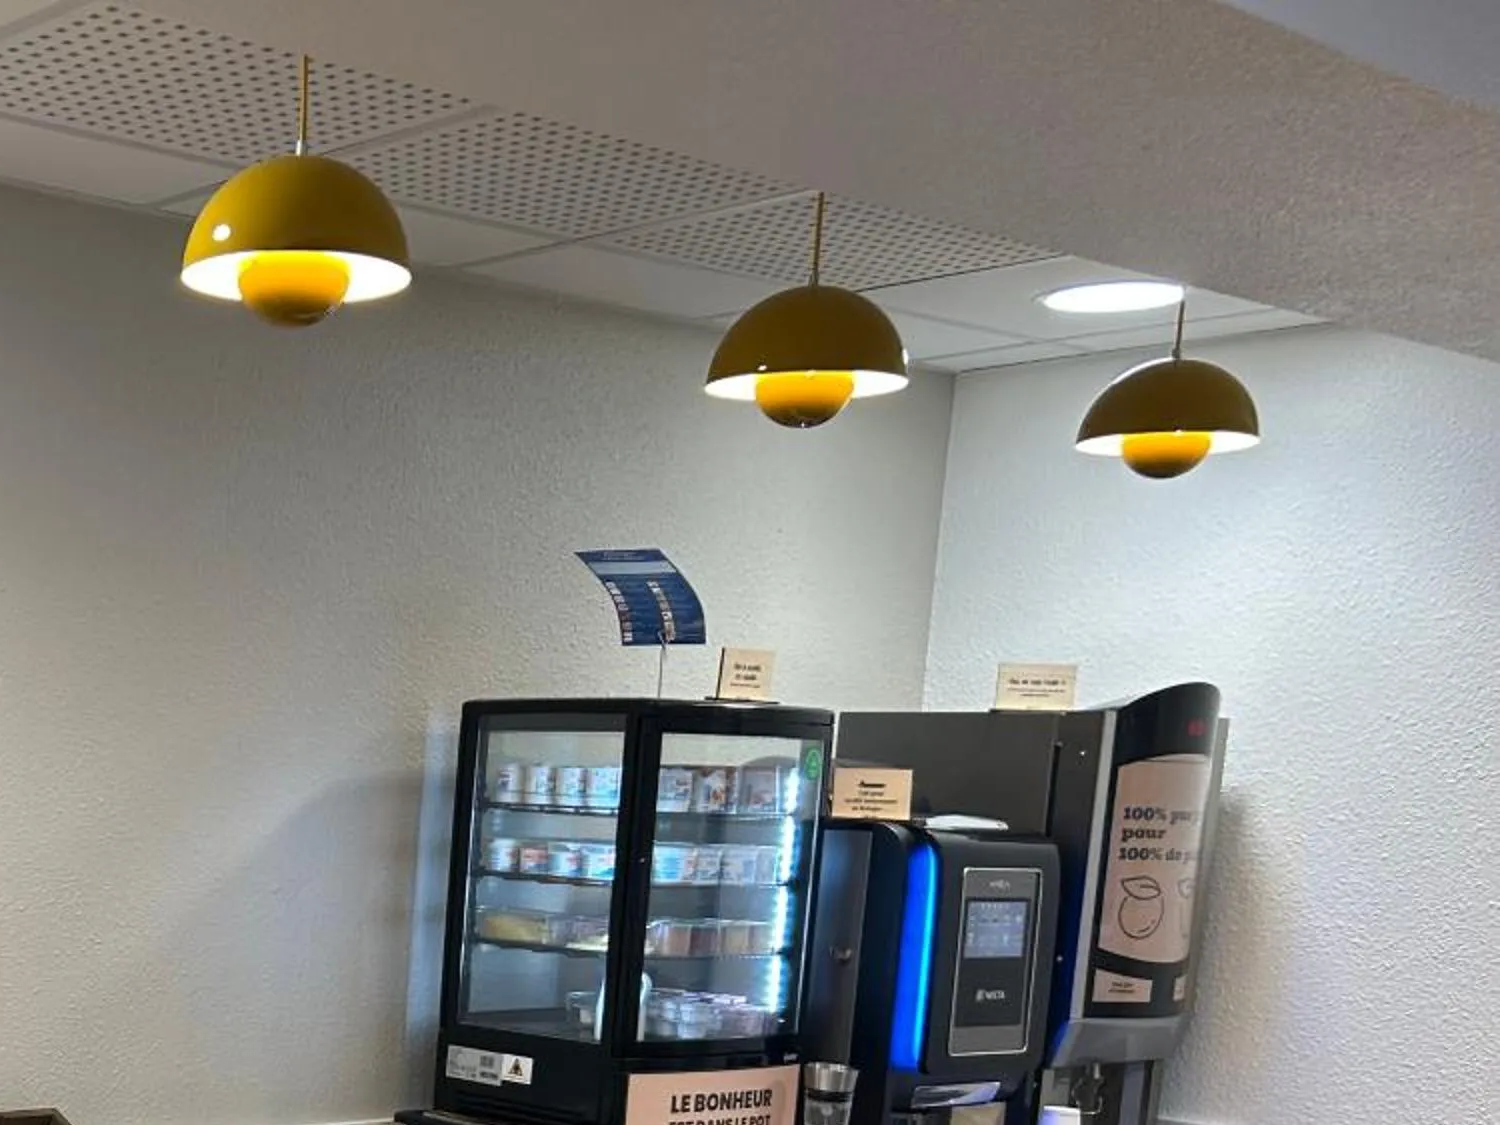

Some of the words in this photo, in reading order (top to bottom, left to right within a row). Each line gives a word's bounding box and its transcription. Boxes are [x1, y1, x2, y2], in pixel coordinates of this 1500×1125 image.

[1121, 827, 1167, 843] pour
[670, 1093, 690, 1114] LE
[694, 1089, 773, 1113] BONHEUR
